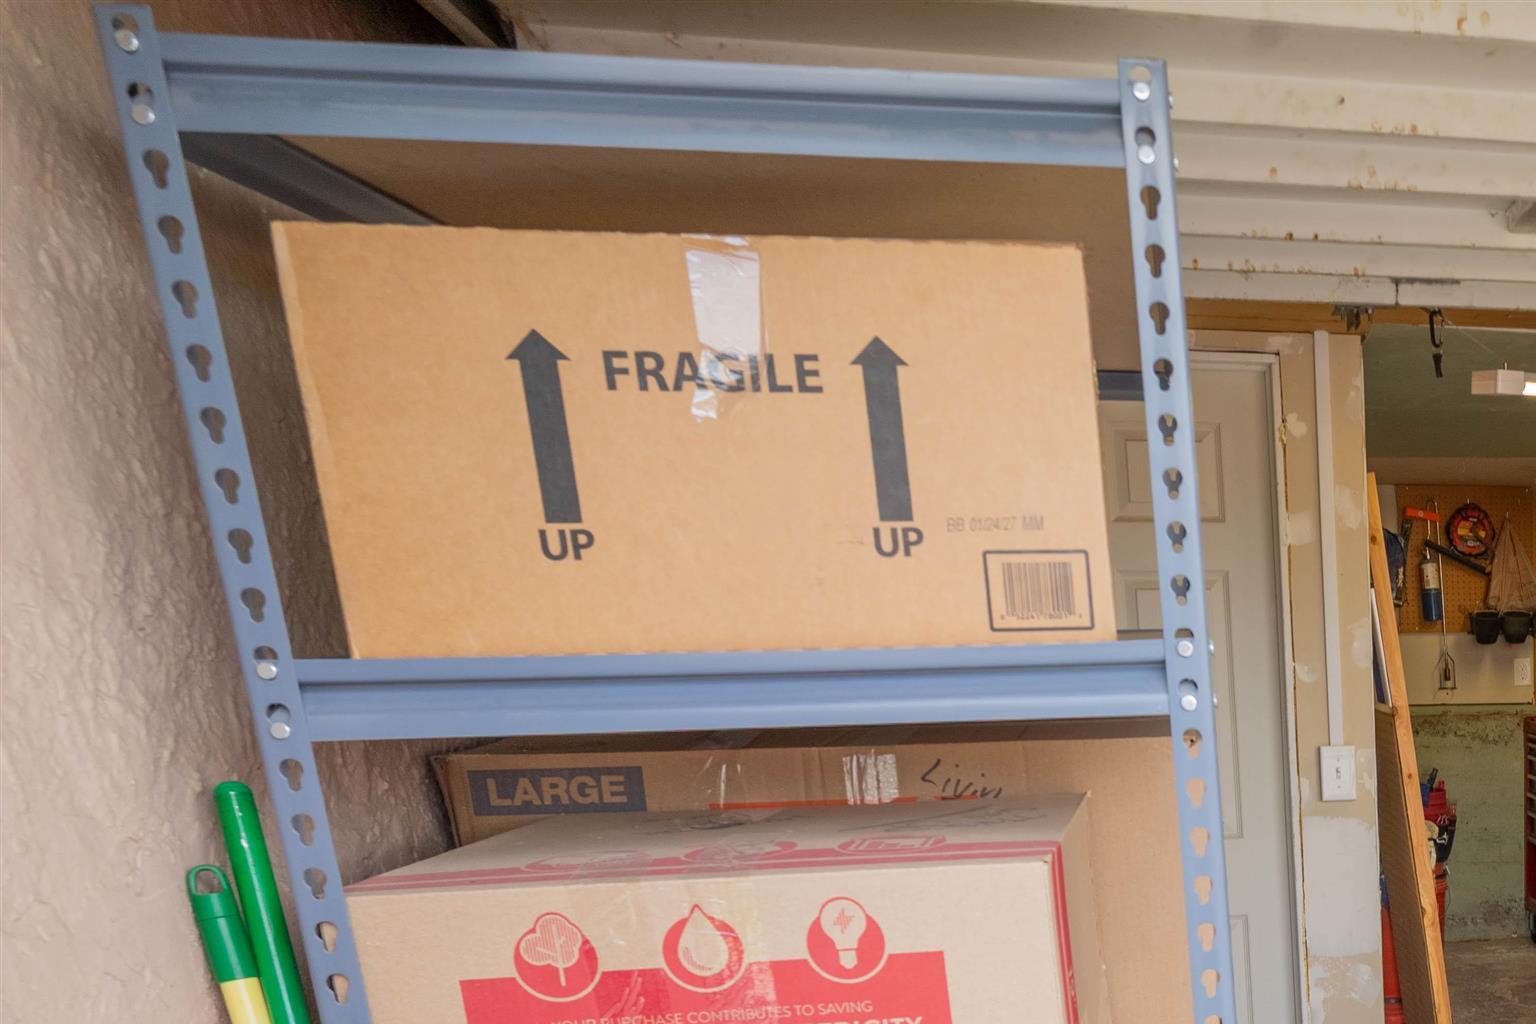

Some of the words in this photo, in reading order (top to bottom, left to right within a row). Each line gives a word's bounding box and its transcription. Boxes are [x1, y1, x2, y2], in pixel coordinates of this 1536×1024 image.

[601, 349, 825, 394] FRAGILE
[539, 527, 595, 562] UP
[873, 525, 925, 559] UP
[484, 774, 630, 809] LARGE
[920, 757, 1003, 800] Livin
[687, 1005, 792, 1024] CONTRIBUTES
[794, 1003, 815, 1018] TO
[817, 999, 873, 1015] SAVING
